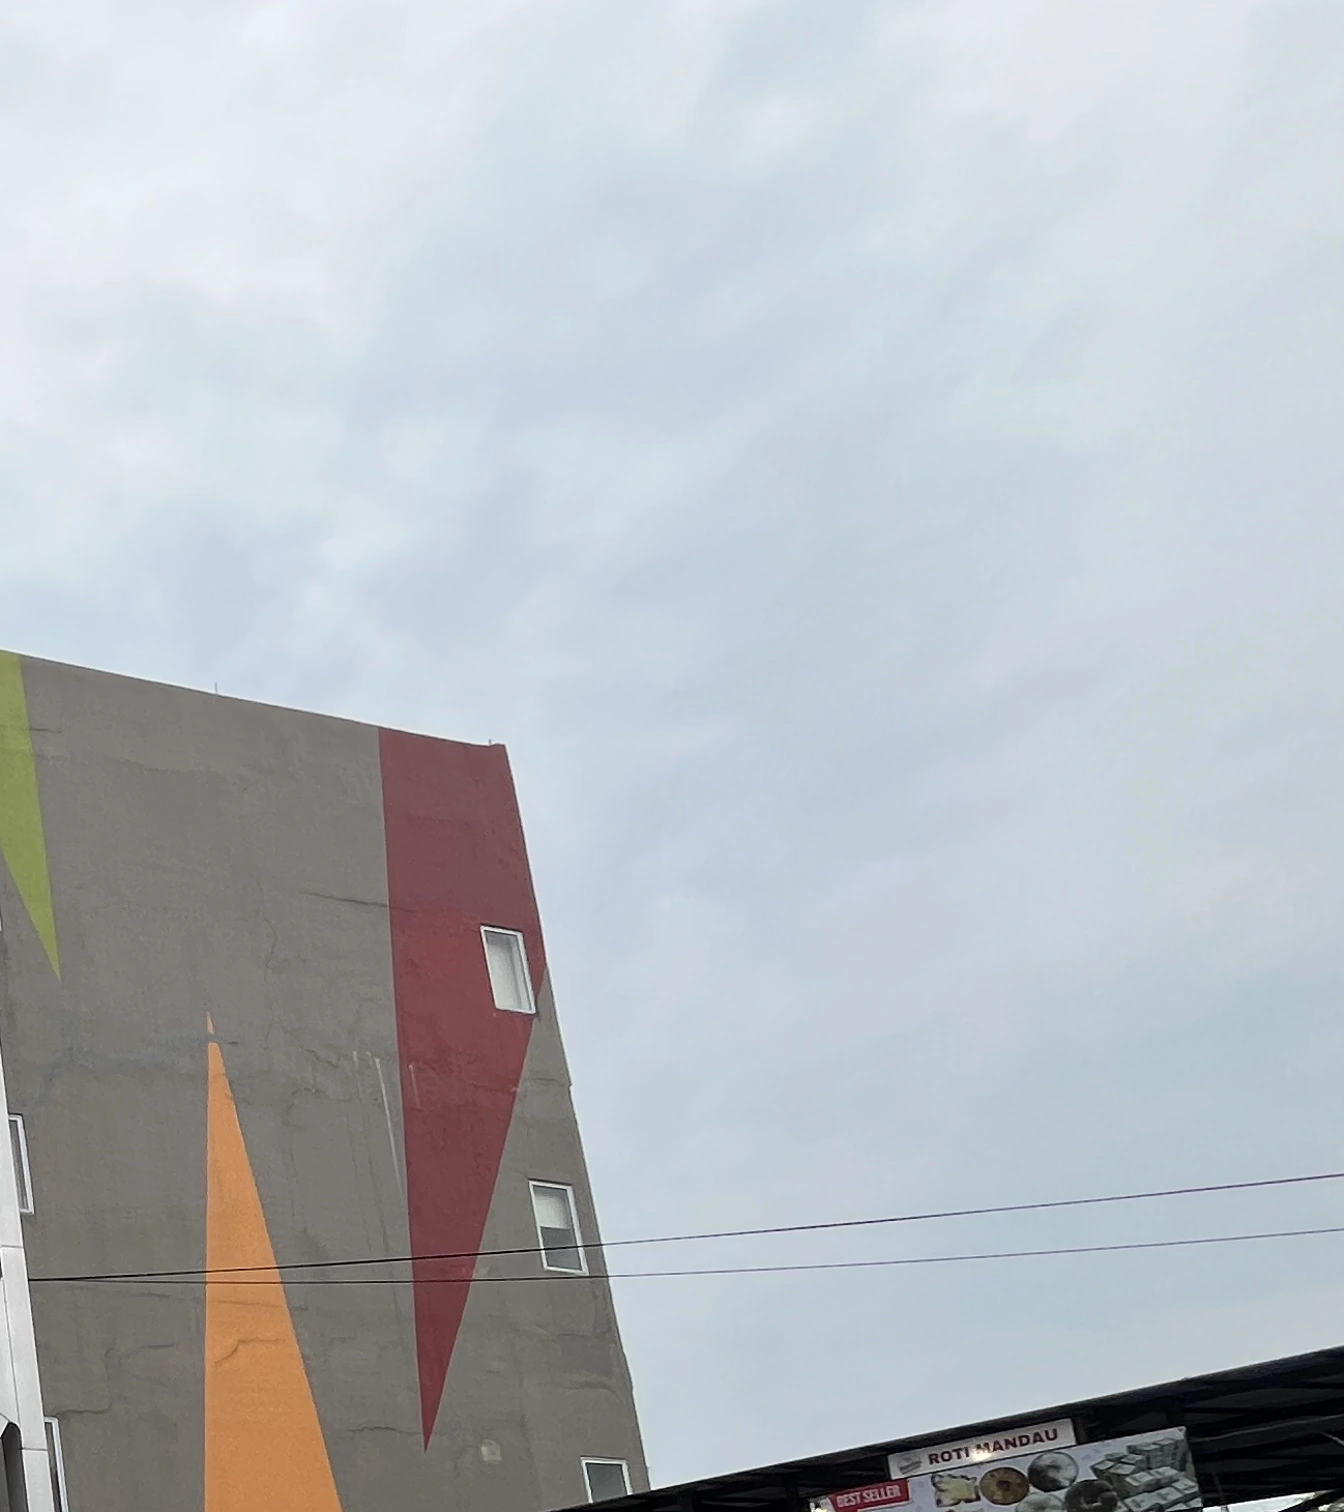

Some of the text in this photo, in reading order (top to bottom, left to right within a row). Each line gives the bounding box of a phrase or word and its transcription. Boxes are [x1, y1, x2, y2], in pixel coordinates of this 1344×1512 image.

[928, 1428, 1059, 1466] ROTI MANDAU
[836, 1484, 902, 1508] BEST SELLER
